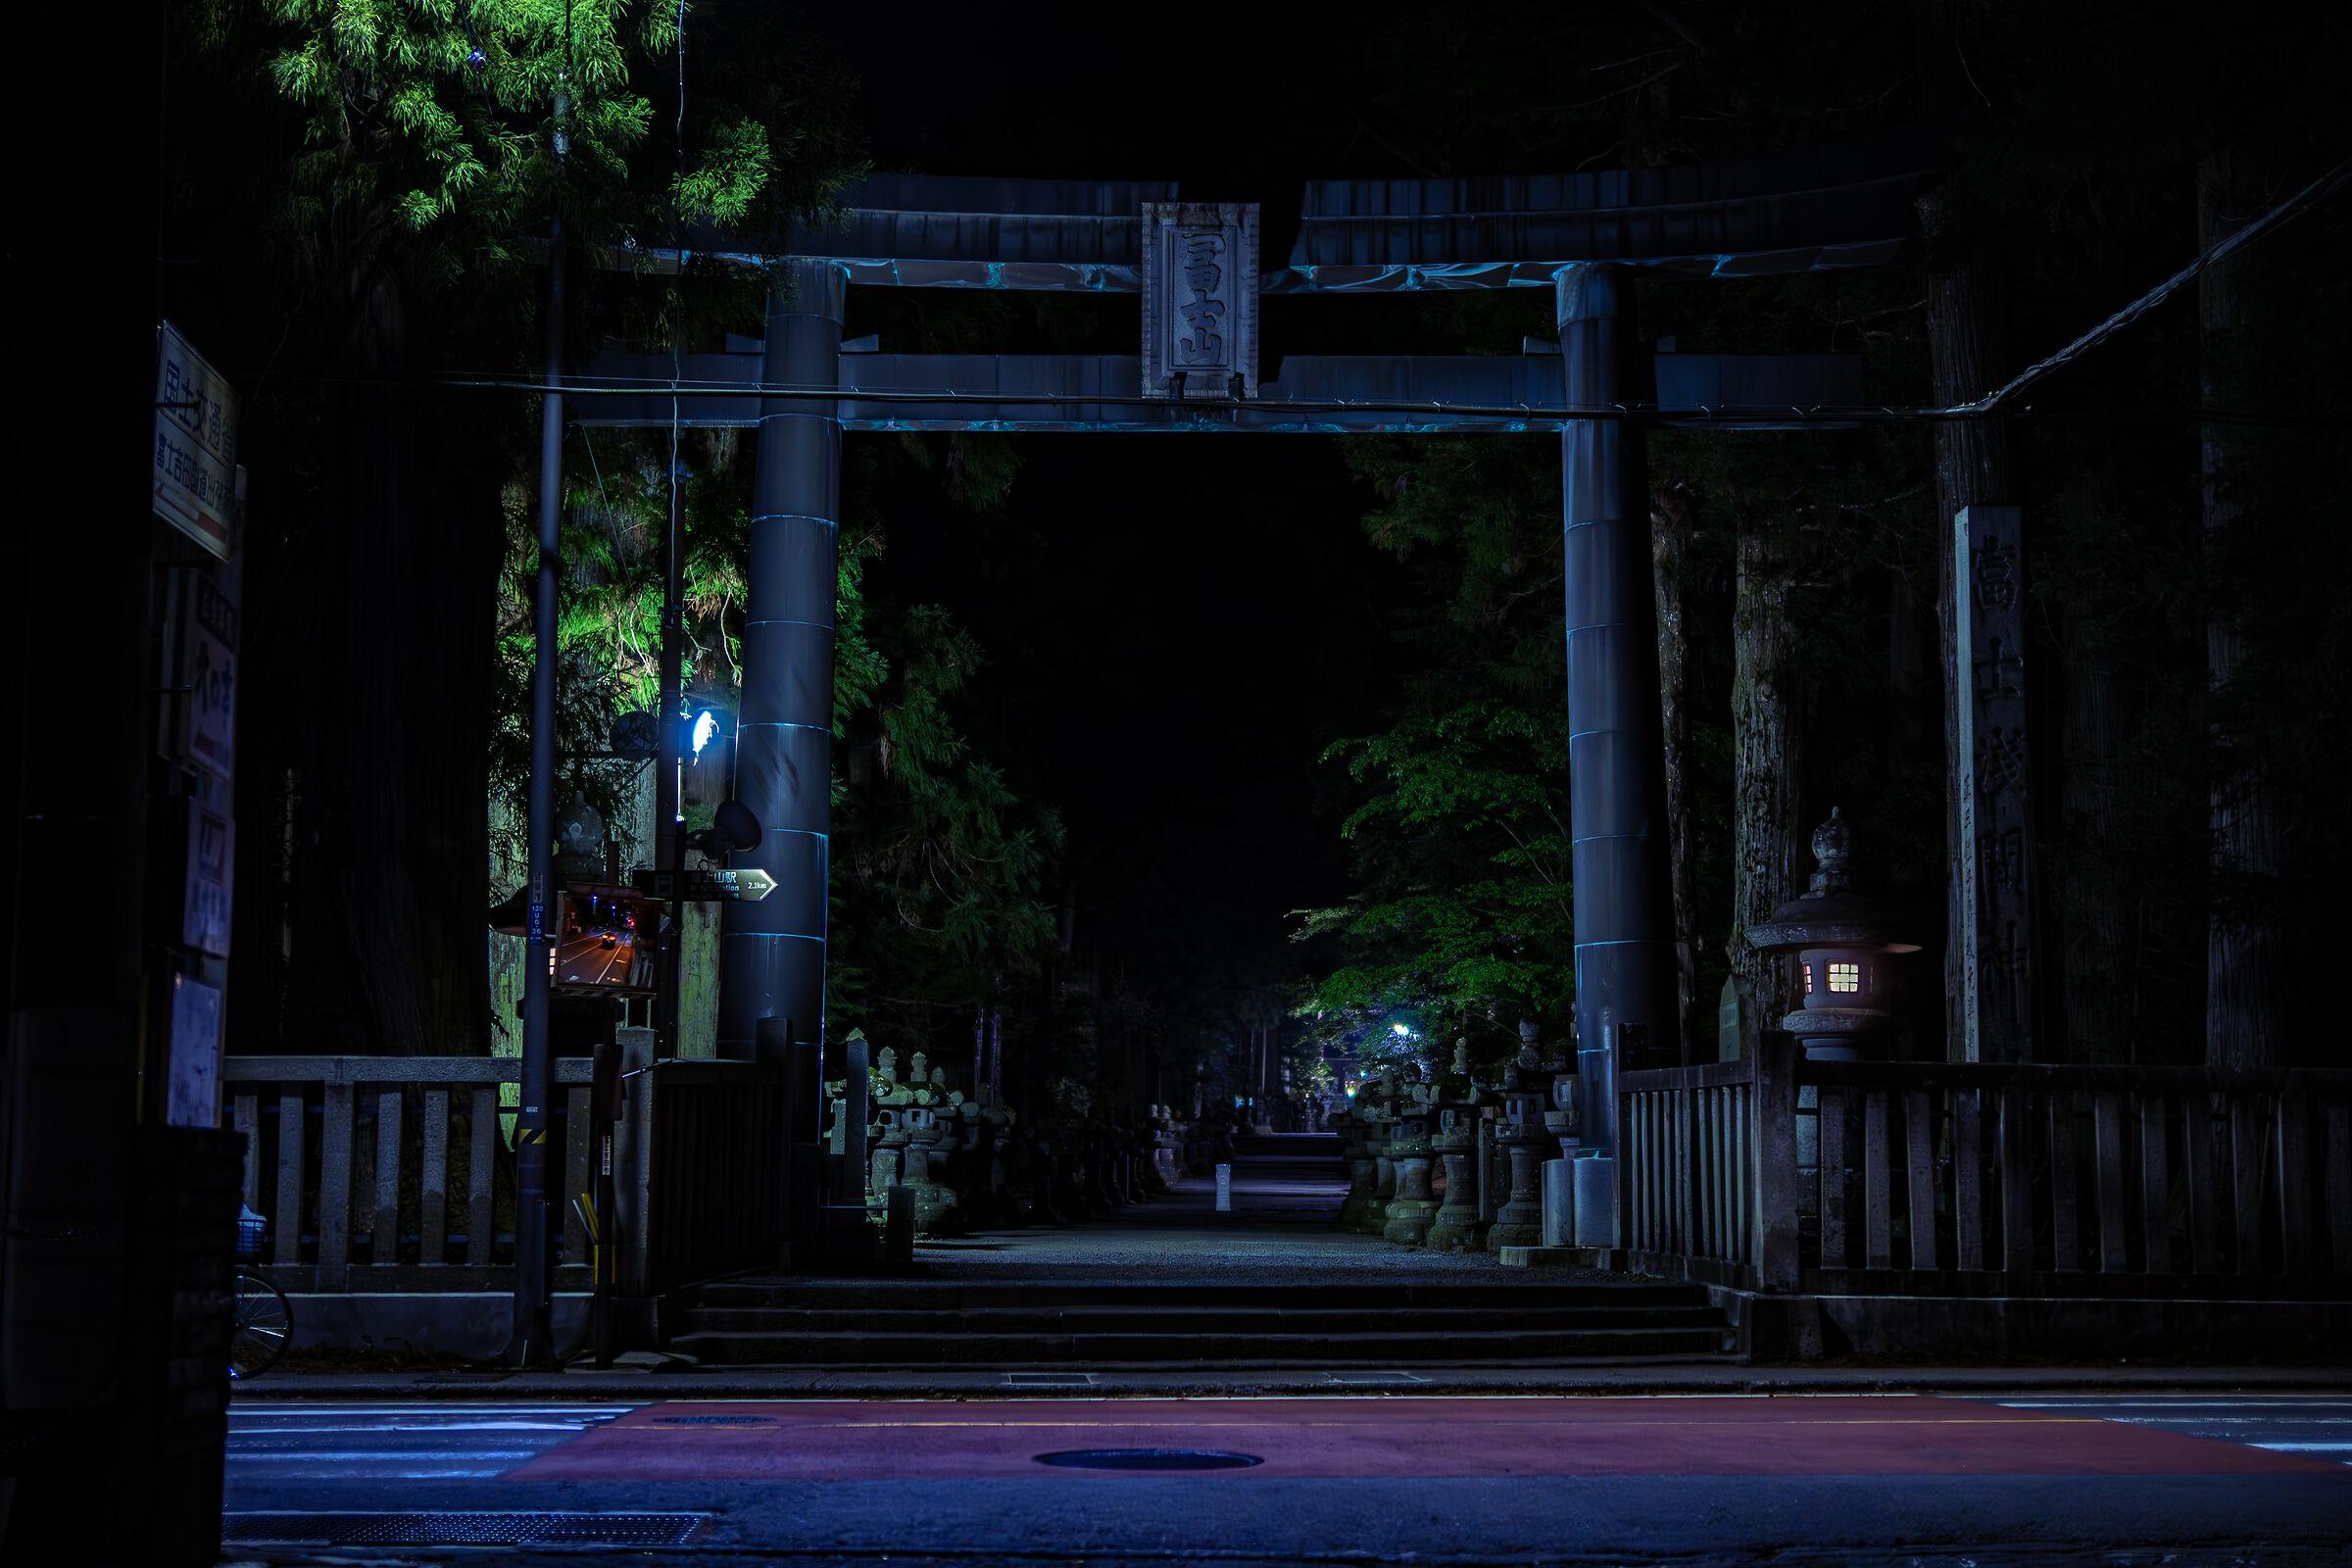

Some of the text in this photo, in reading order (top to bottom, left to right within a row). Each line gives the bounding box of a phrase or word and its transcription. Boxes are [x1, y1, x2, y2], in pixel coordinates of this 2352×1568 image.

[164, 359, 234, 466] 国土交通省
